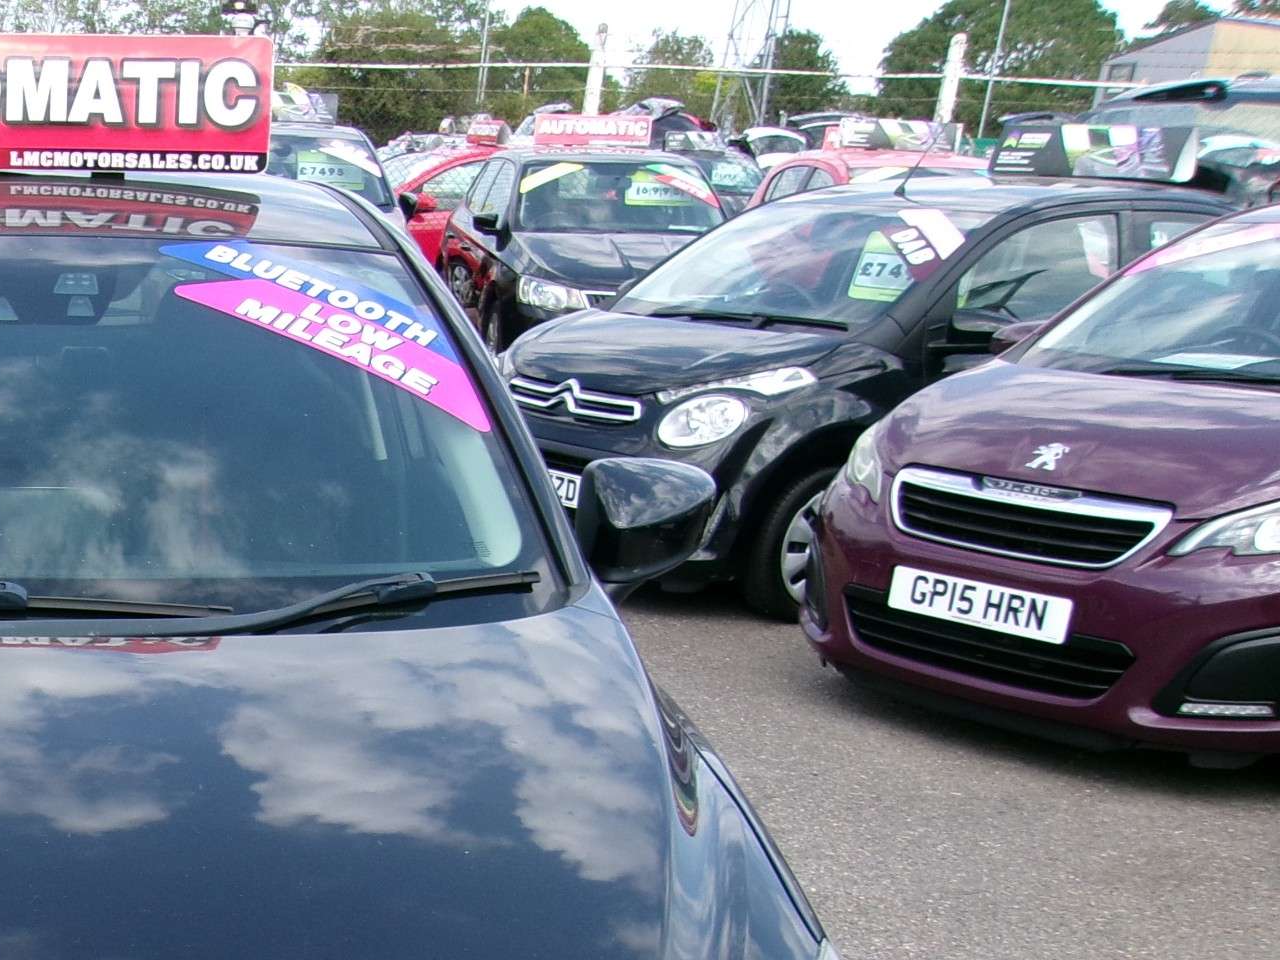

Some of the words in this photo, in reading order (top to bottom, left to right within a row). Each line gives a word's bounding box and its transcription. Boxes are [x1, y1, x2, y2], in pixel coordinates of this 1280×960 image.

[539, 119, 649, 137] AUTOMATIC
[9, 150, 259, 171] LMCMOTORSALES.CO.UK
[299, 166, 345, 176] £7495
[890, 228, 935, 265] DAB
[859, 262, 904, 279] £74
[204, 245, 439, 347] BLUETOOTH
[299, 302, 405, 351] LOW
[234, 297, 440, 396] MILEAGE
[550, 475, 577, 501] ZD
[910, 575, 977, 615] GP15
[982, 589, 1048, 631] HRN
